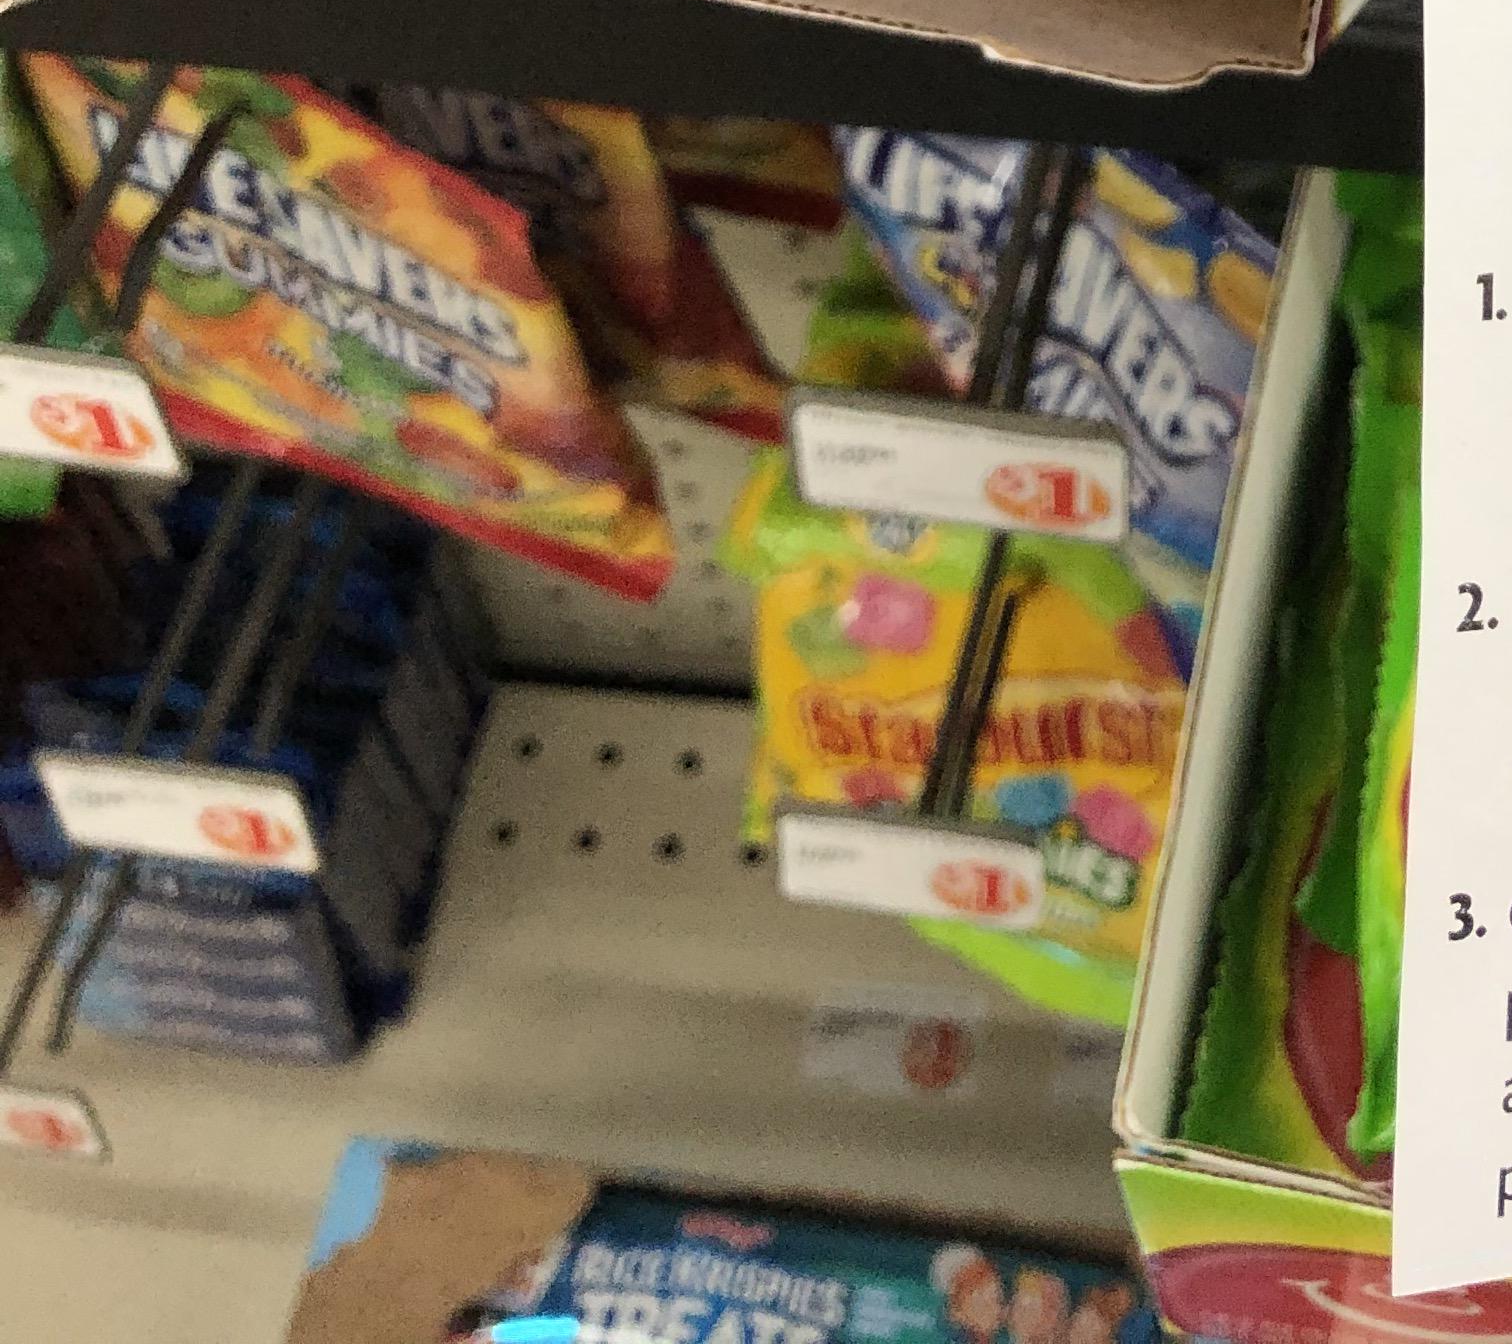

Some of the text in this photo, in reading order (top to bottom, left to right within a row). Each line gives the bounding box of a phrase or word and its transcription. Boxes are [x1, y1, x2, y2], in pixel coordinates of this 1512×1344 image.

[1477, 274, 1506, 320] 1.
[1457, 584, 1498, 632] 2.
[1449, 894, 1486, 940] 3.
